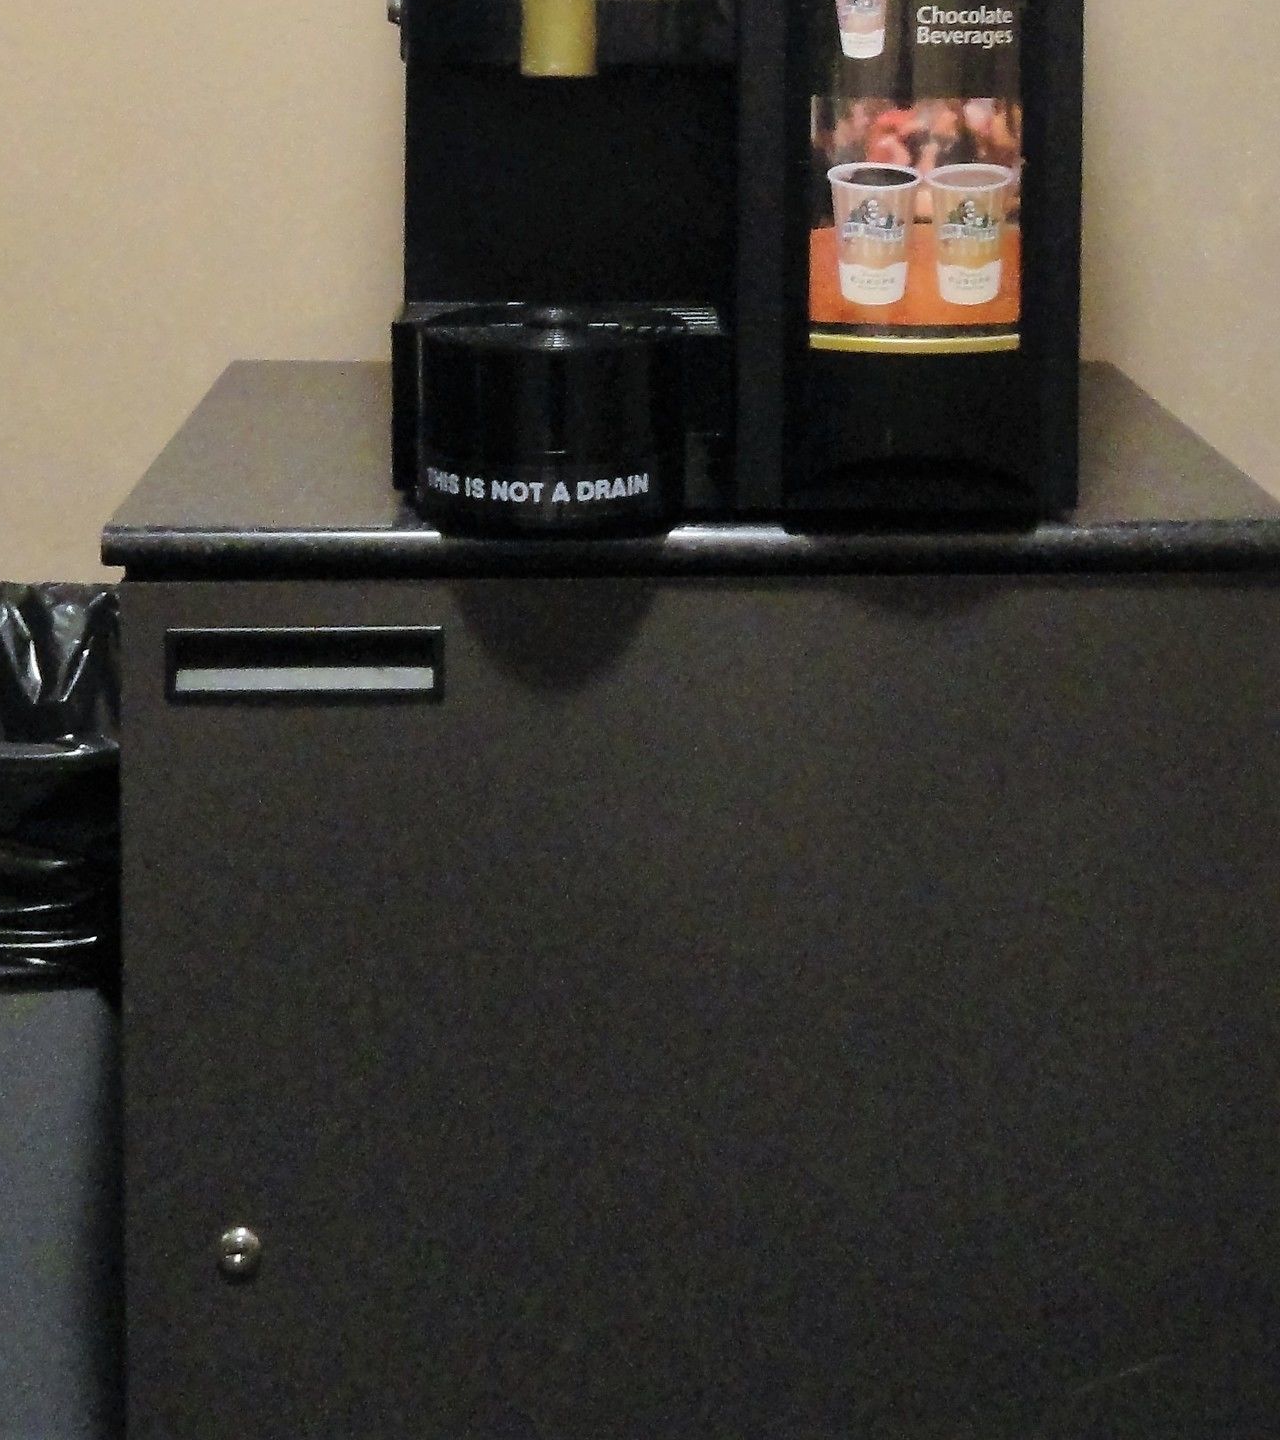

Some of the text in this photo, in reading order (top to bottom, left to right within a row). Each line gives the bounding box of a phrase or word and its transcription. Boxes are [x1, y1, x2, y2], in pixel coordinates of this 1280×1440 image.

[915, 5, 1013, 25] Chocolate
[915, 26, 1013, 49] Beverages
[426, 466, 650, 503] THIS IS NOT A DRAIN
